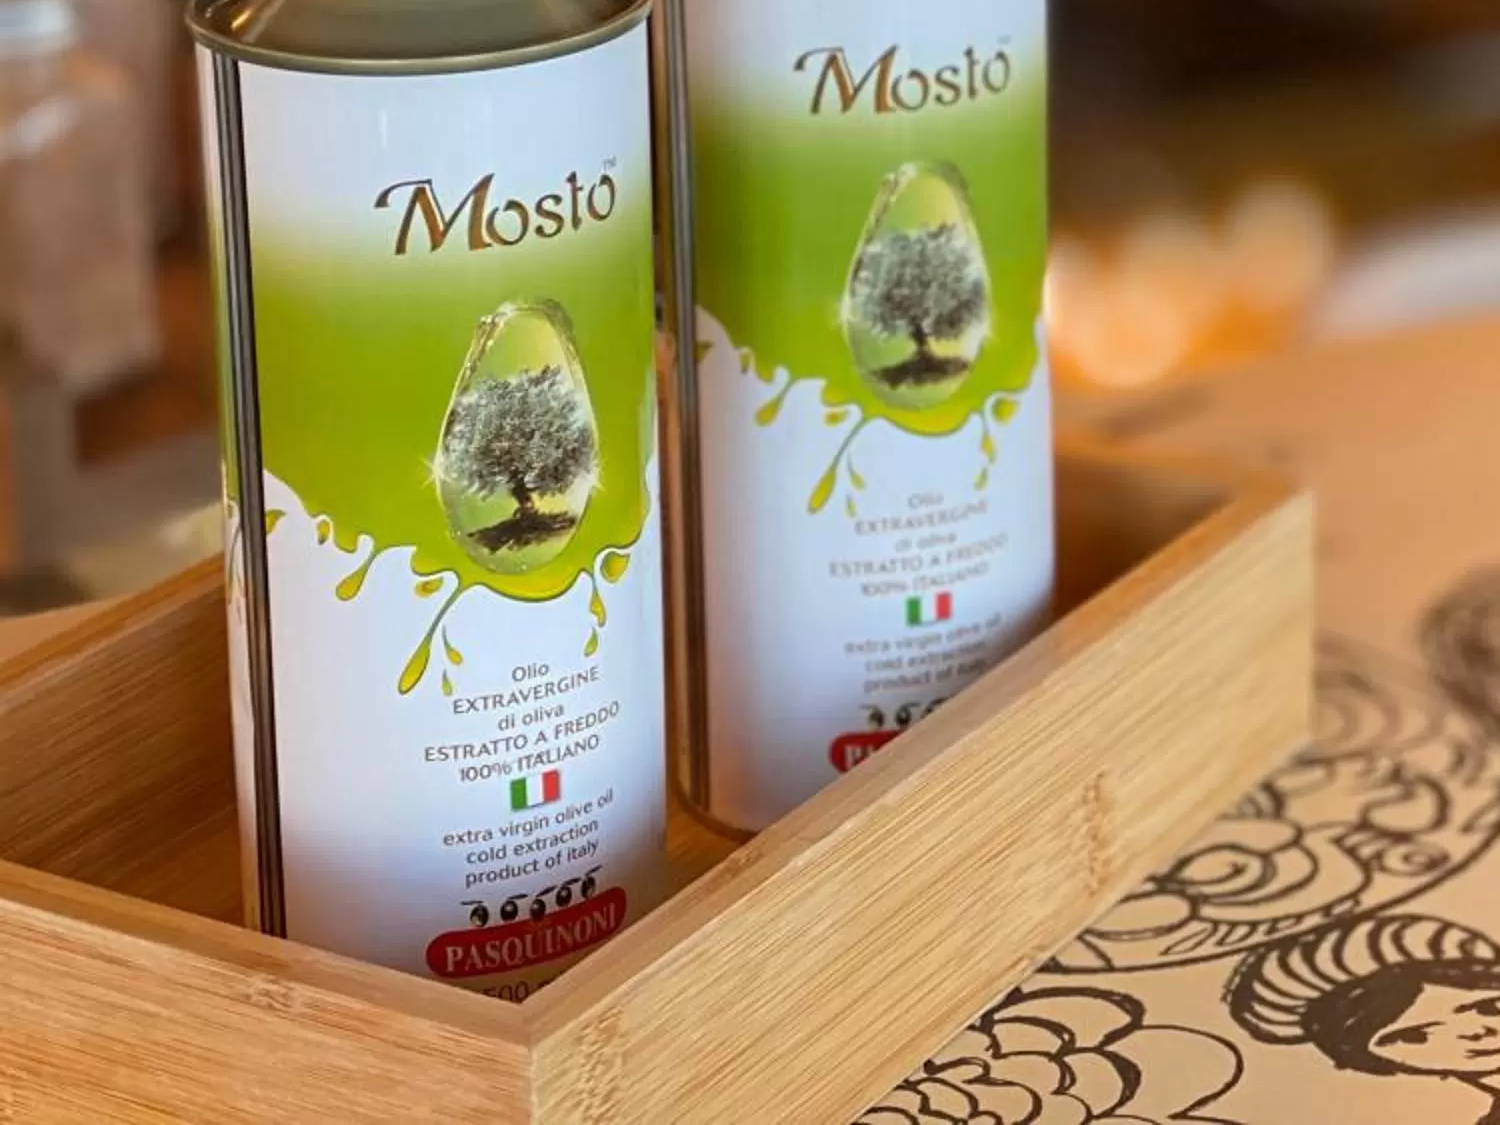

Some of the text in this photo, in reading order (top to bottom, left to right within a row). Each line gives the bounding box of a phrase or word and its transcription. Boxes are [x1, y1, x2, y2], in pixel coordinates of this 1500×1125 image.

[793, 43, 1011, 115] Mosto
[373, 170, 616, 255] Mosto
[453, 665, 600, 715] EXTRAVERGINE
[511, 662, 550, 683] Olio
[424, 700, 620, 763] ESTRATTO A FREDDO
[498, 702, 565, 732] di oliva
[459, 733, 600, 783] 100% ITALIANO
[443, 787, 615, 847] extra virgin olive oil
[466, 819, 600, 865] cold extraction
[465, 838, 600, 889] product of italy
[445, 902, 616, 973] PASQUINONI
